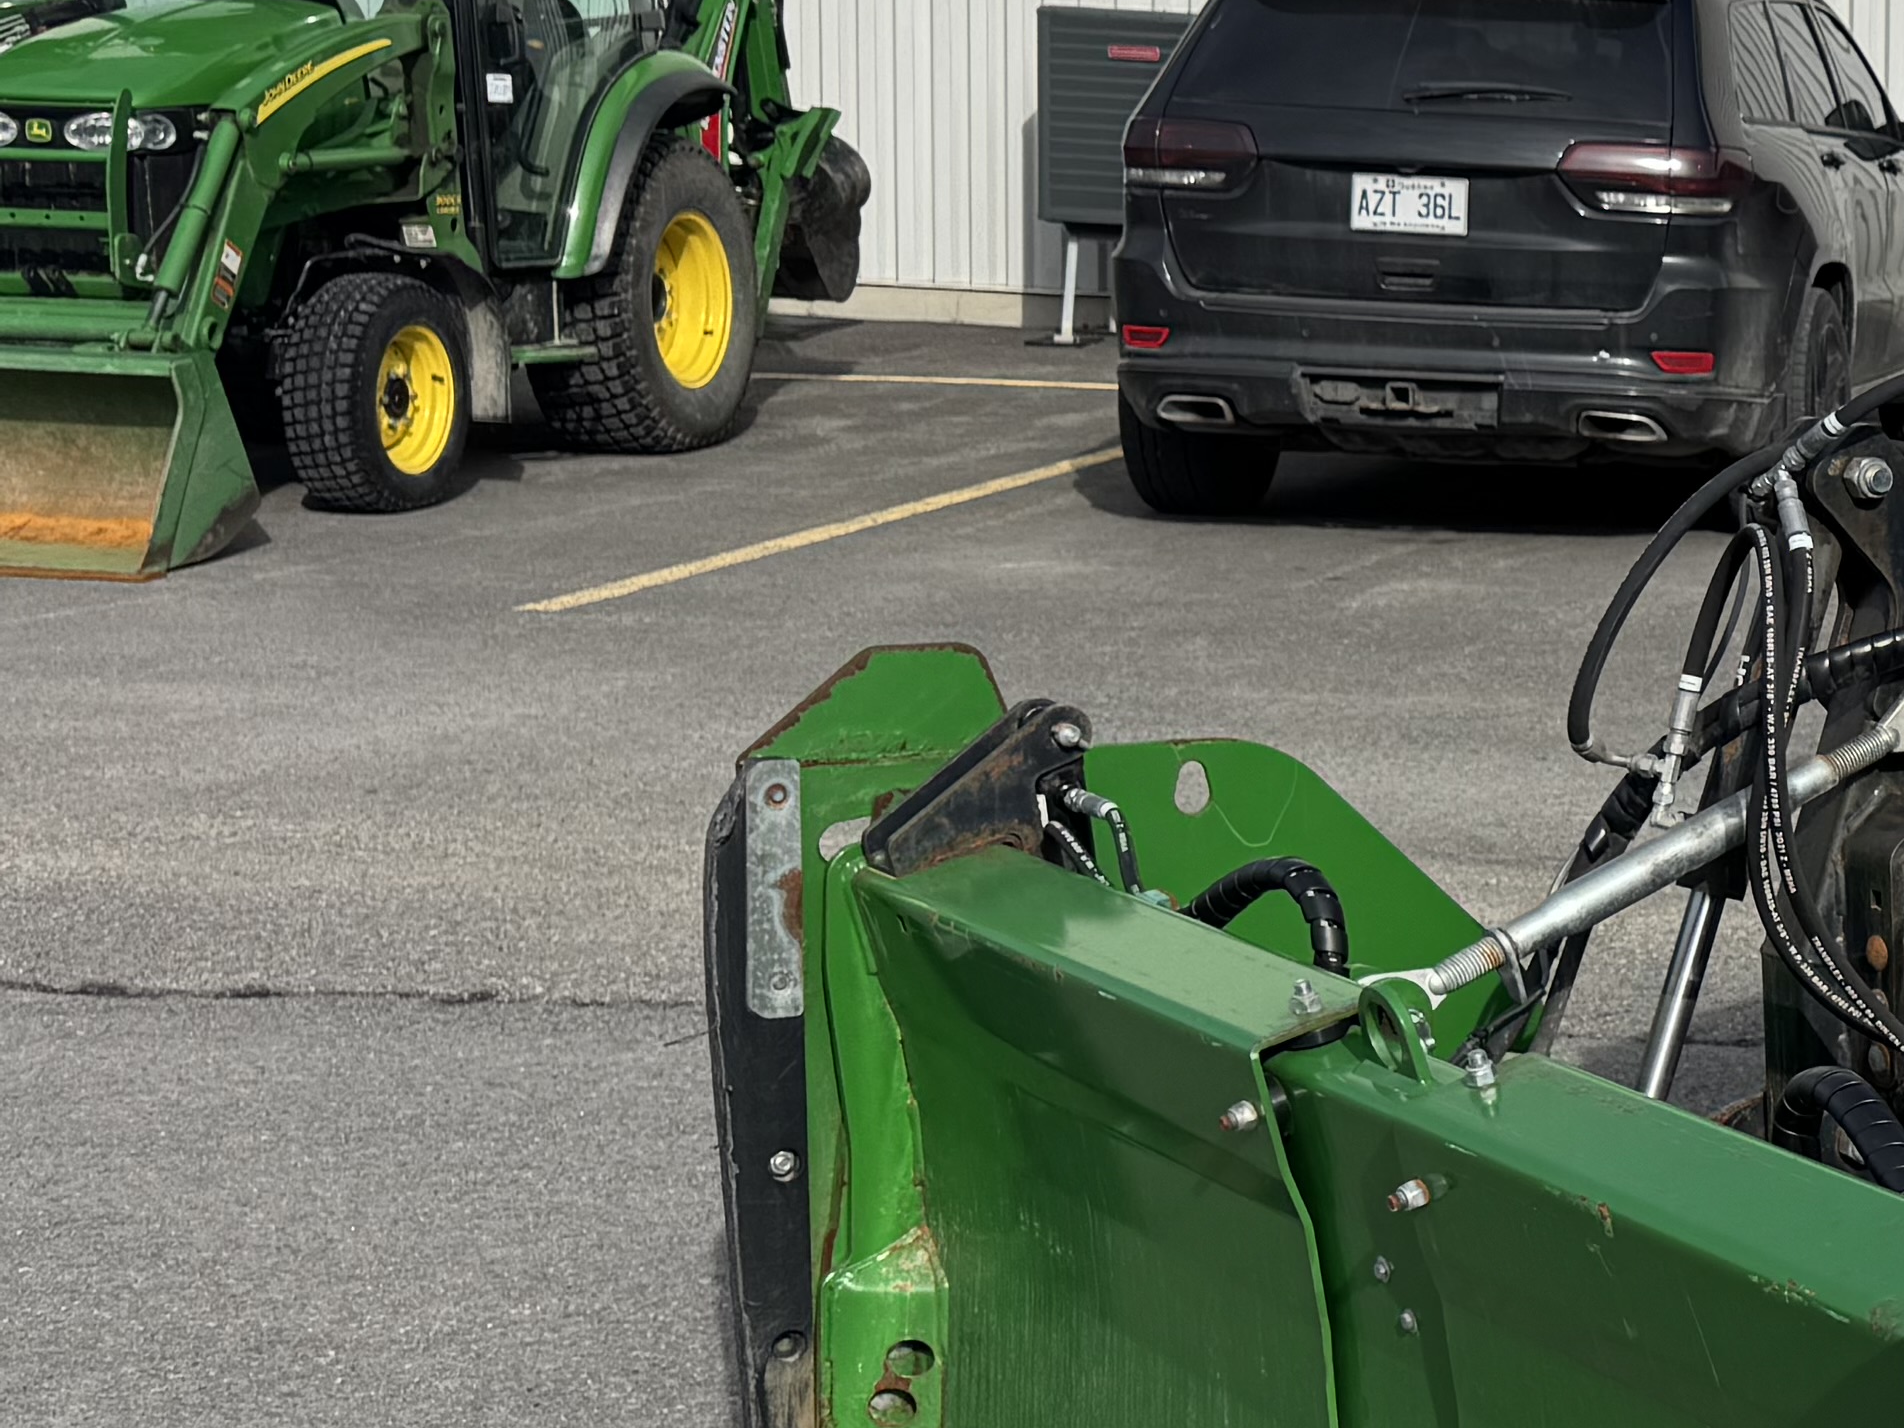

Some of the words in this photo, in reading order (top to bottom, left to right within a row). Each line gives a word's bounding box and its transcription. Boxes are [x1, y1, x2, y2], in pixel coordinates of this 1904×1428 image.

[1358, 188, 1401, 218] AZT
[1417, 192, 1461, 221] 36L
[1768, 757, 1777, 780] BAR
[1811, 935, 1844, 981] TRANSFLEX
